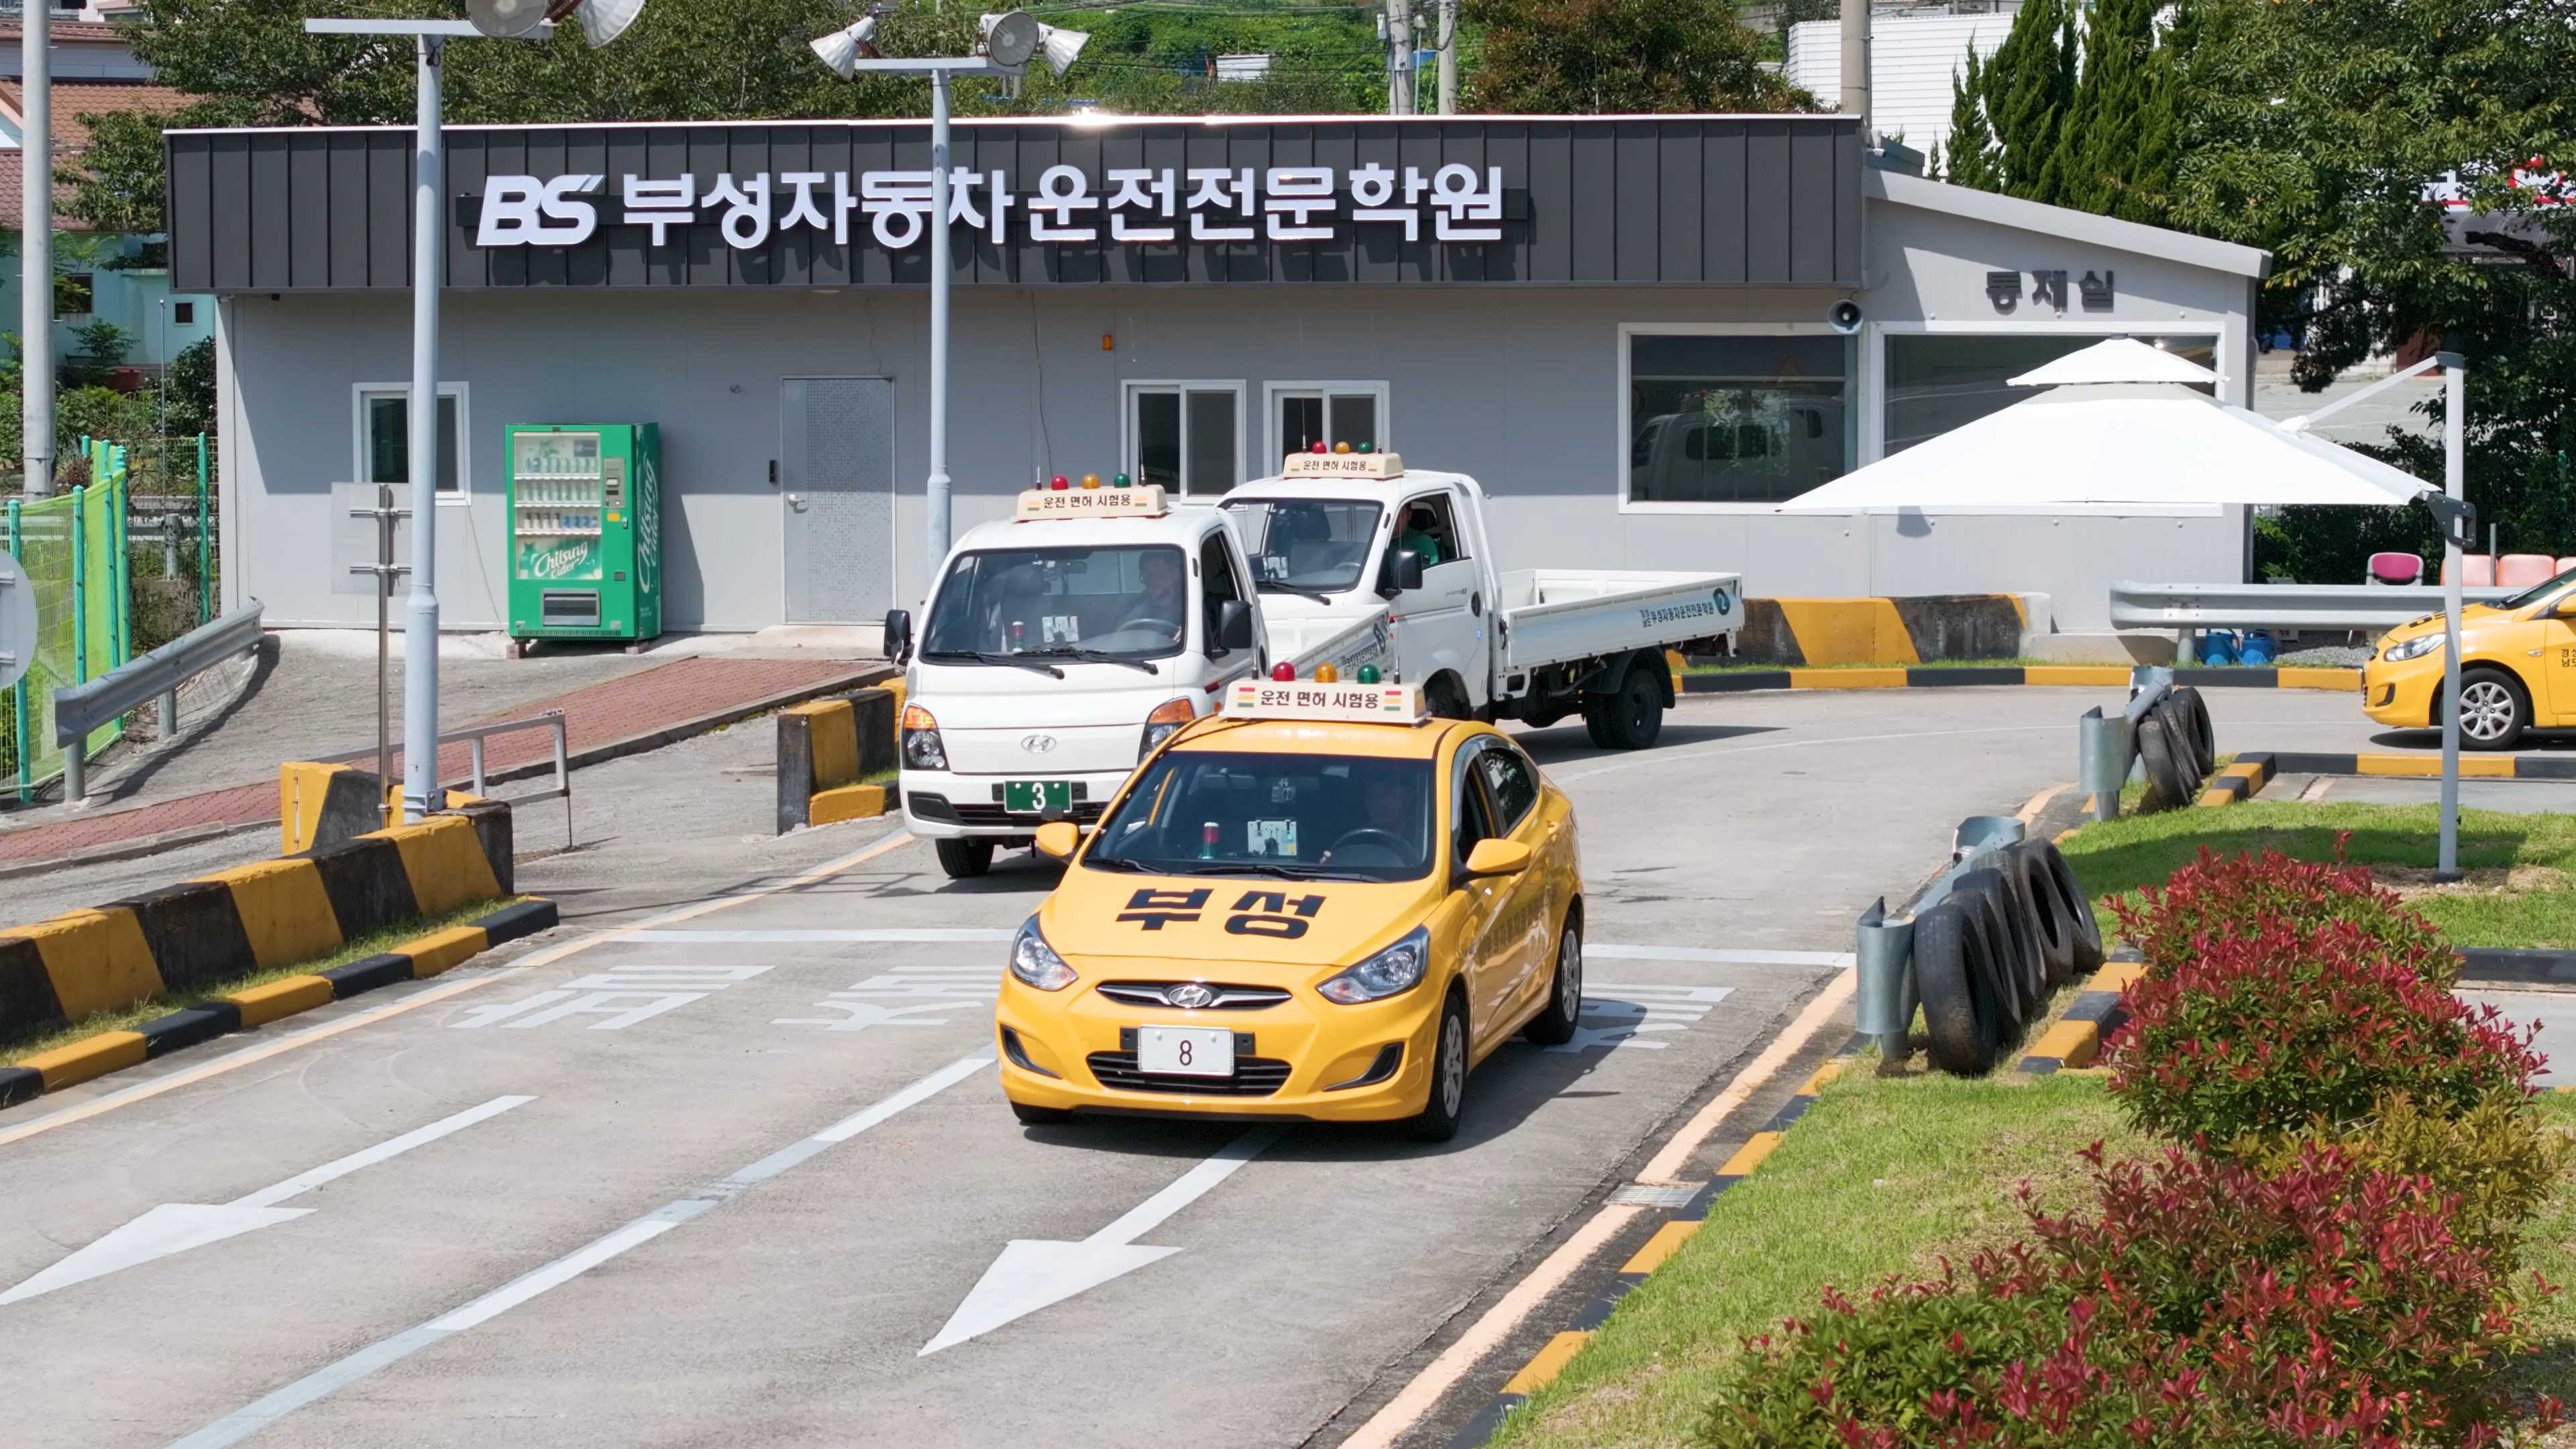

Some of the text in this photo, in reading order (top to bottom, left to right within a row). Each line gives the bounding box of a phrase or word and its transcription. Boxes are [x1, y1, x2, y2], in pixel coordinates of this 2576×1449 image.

[476, 174, 606, 246] BS
[1303, 460, 1366, 471] 운전 면허 시험용
[1044, 494, 1131, 508] 운전 면허 시험용
[531, 541, 588, 577] Chilsung
[1261, 690, 1379, 709] 운전 면허 시험용
[1032, 782, 1046, 810] 3
[1115, 888, 1327, 939] 부성
[1179, 1039, 1193, 1067] 8
